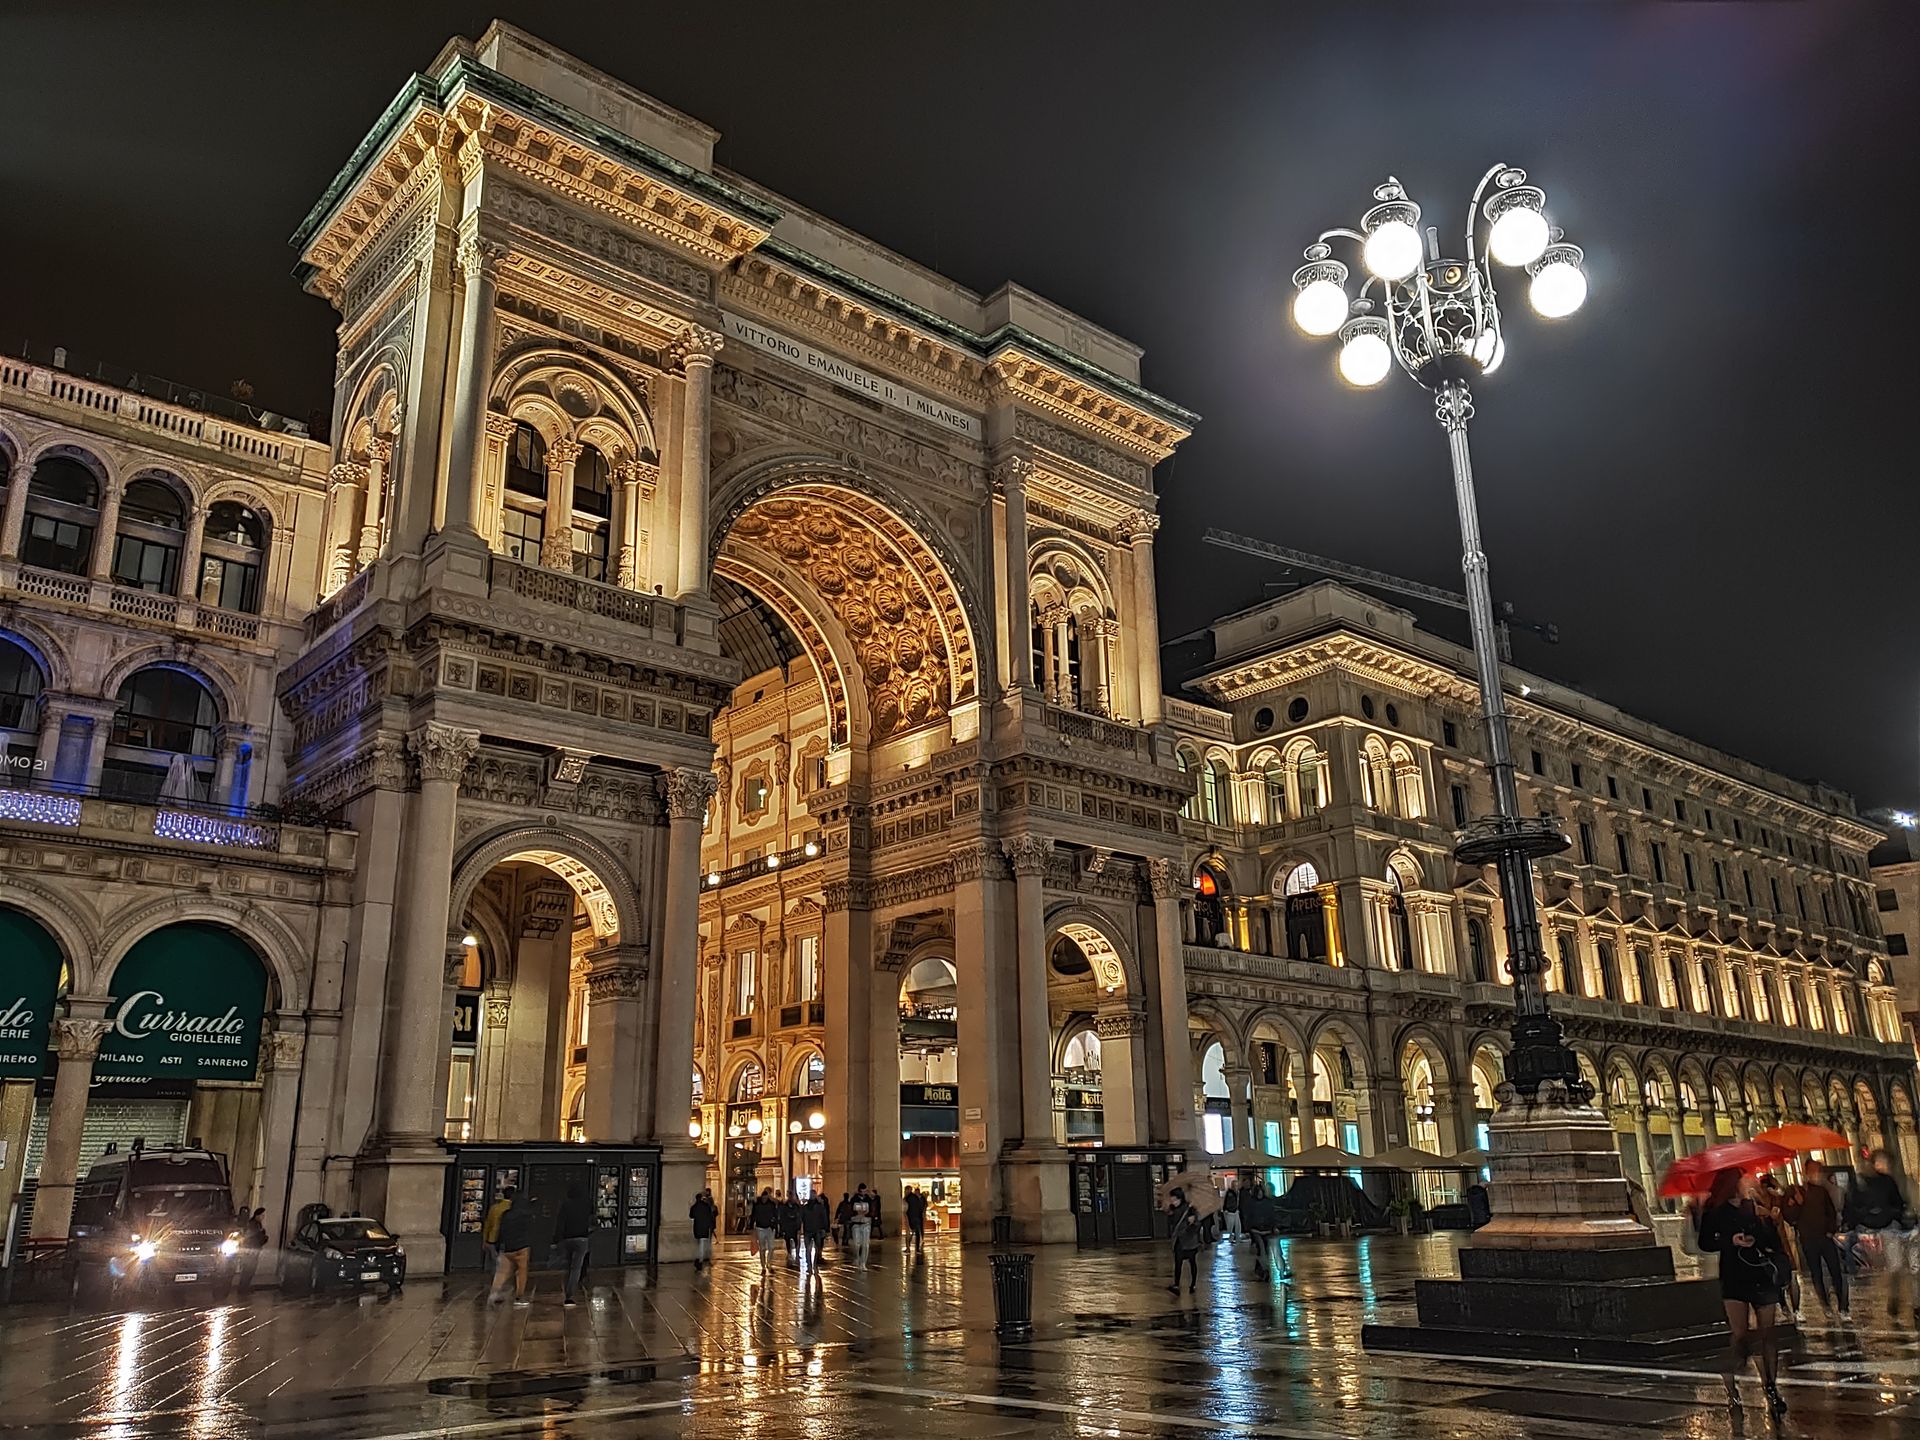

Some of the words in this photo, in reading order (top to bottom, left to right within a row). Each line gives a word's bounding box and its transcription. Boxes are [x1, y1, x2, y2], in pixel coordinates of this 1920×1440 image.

[718, 315, 726, 328] A
[735, 322, 800, 359] VITTORIO
[807, 354, 879, 393] EMANUELE
[916, 400, 970, 431] MILANESI
[33, 759, 47, 771] 21
[116, 990, 245, 1039] Currado
[169, 1032, 242, 1045] GIOIELLERIE
[99, 1053, 145, 1063] MILANO
[160, 1056, 183, 1065] ASTI
[197, 1057, 249, 1067] SANREMO
[924, 1087, 953, 1101] Motta
[731, 1109, 757, 1126] Mott
